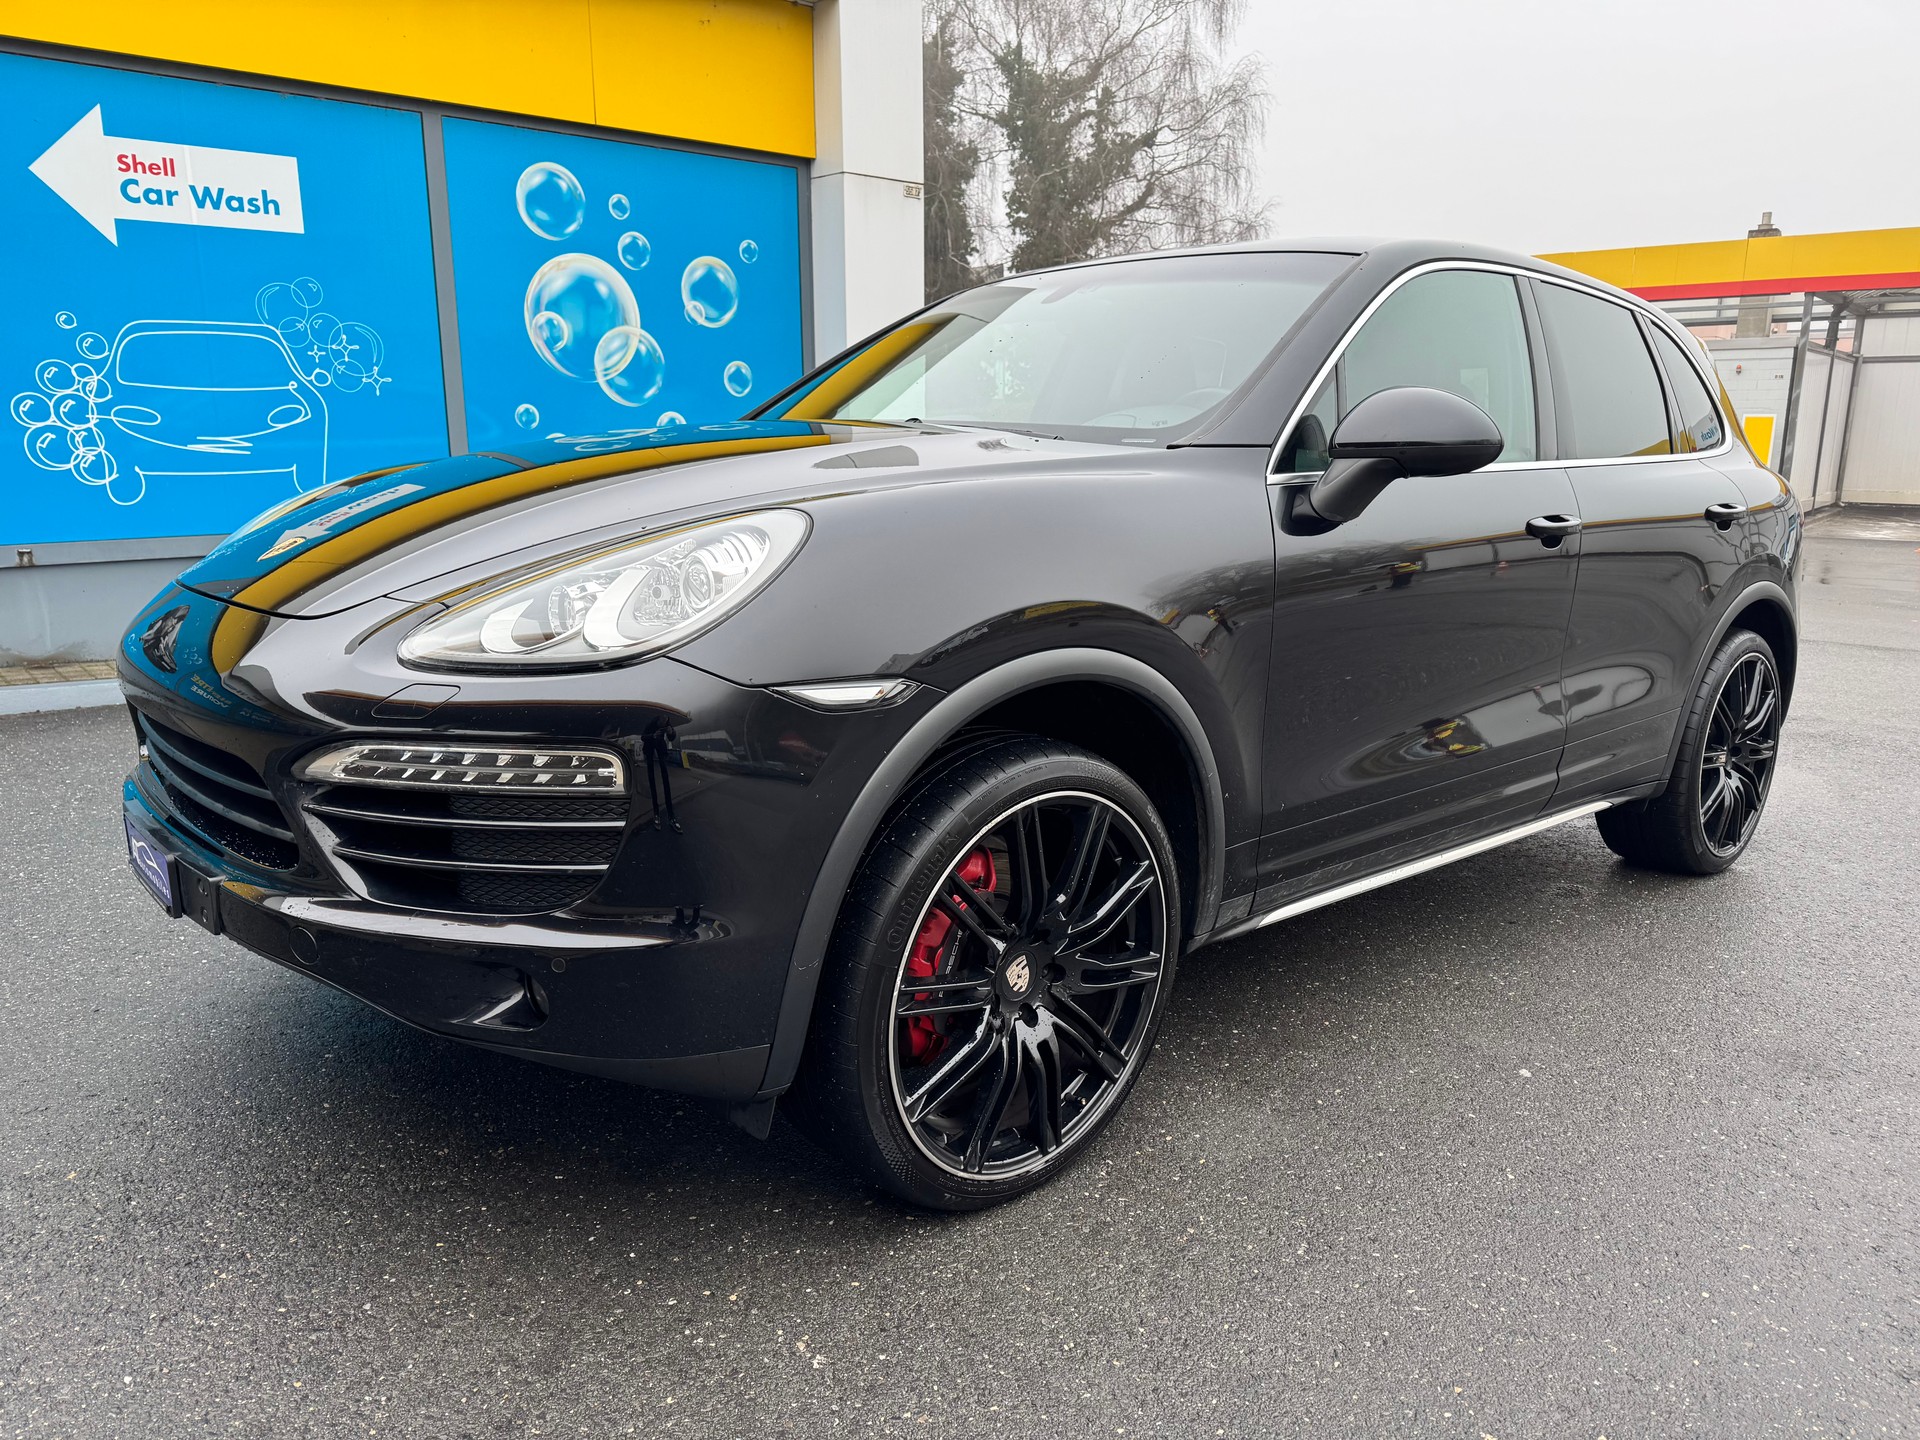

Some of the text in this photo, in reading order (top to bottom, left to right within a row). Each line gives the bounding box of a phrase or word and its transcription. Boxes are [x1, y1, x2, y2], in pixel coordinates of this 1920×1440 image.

[116, 154, 176, 177] Shell
[119, 178, 281, 216] Car Wash
